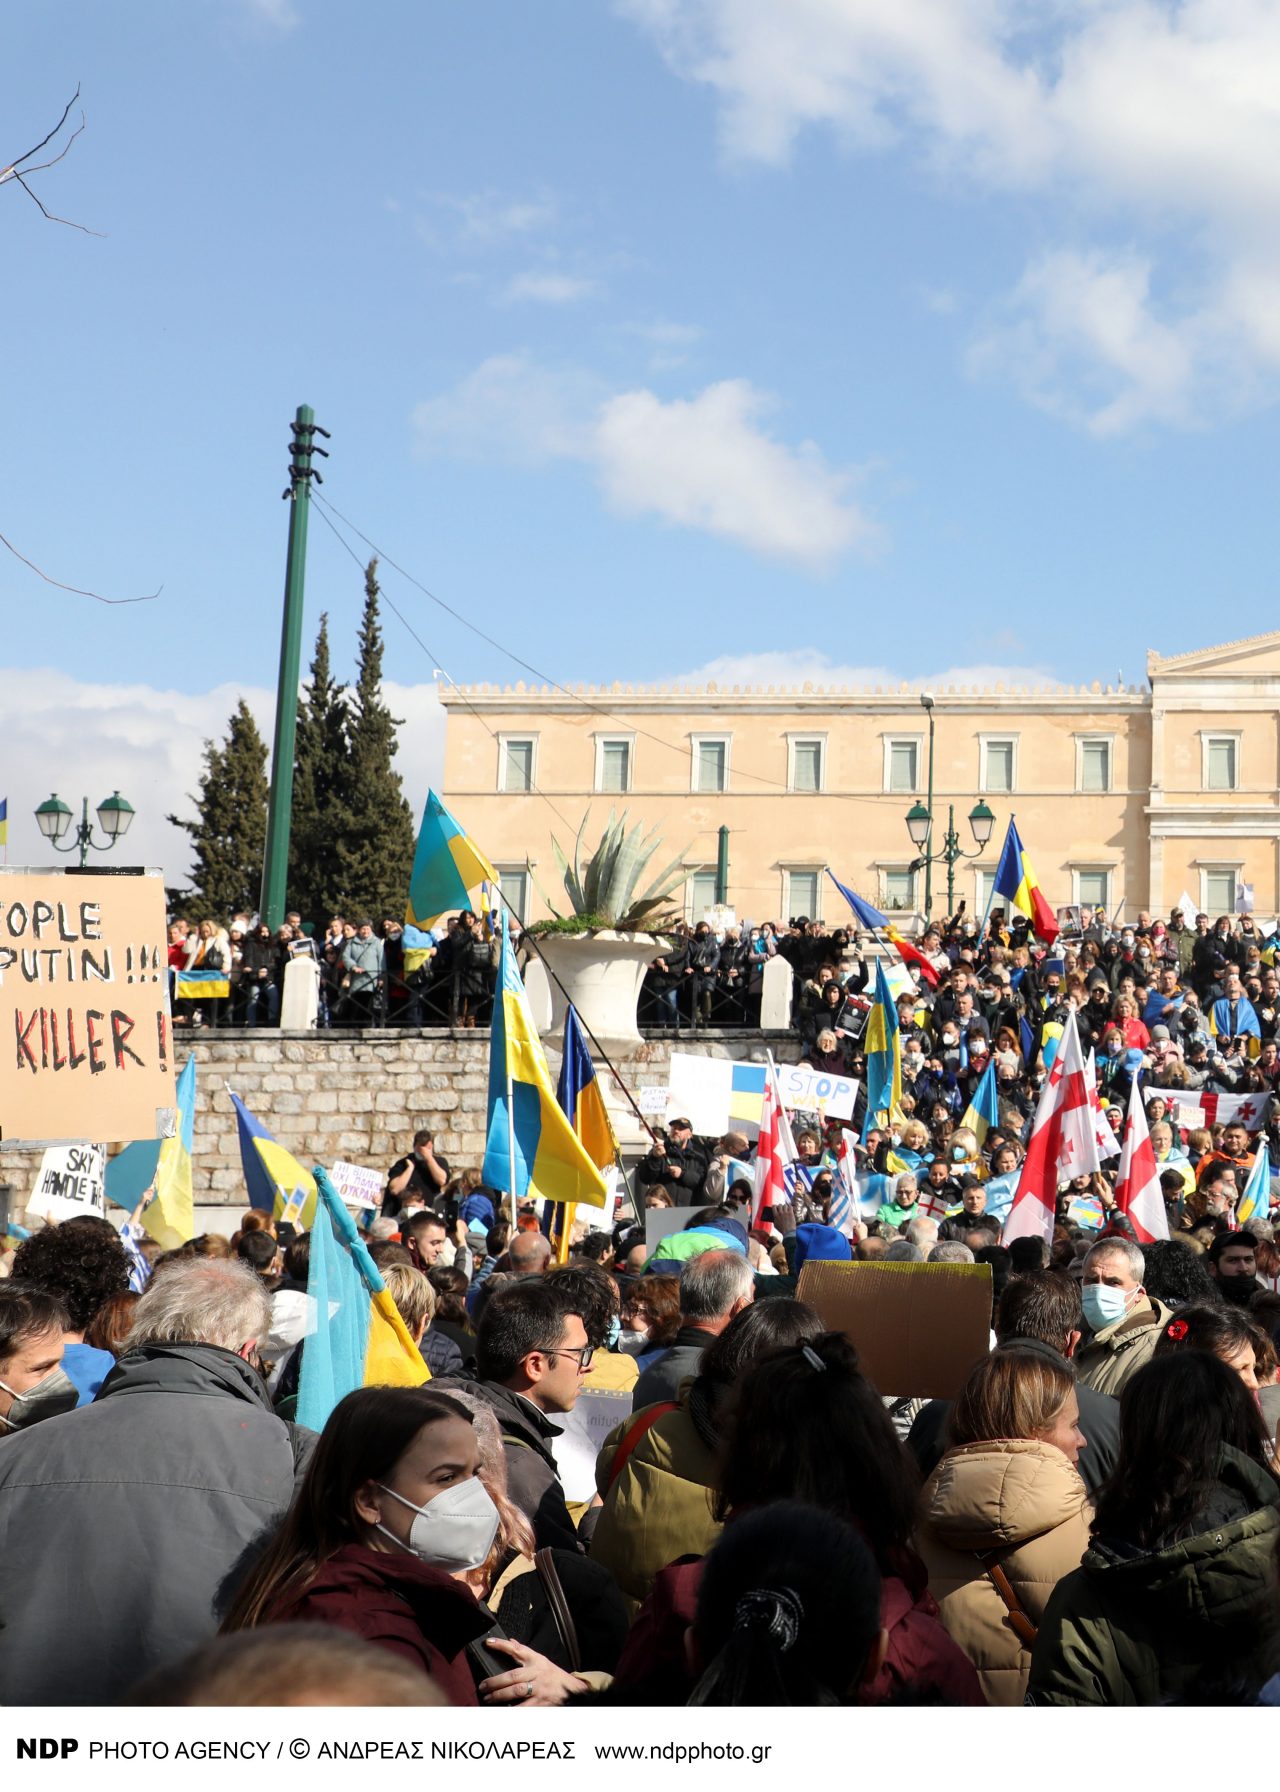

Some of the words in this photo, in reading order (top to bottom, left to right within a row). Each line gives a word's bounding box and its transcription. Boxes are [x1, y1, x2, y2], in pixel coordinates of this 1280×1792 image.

[15, 1006, 145, 1075] KILLER
[788, 1072, 850, 1099] STOP
[792, 1094, 827, 1108] WAR
[66, 1148, 94, 1174] SKY
